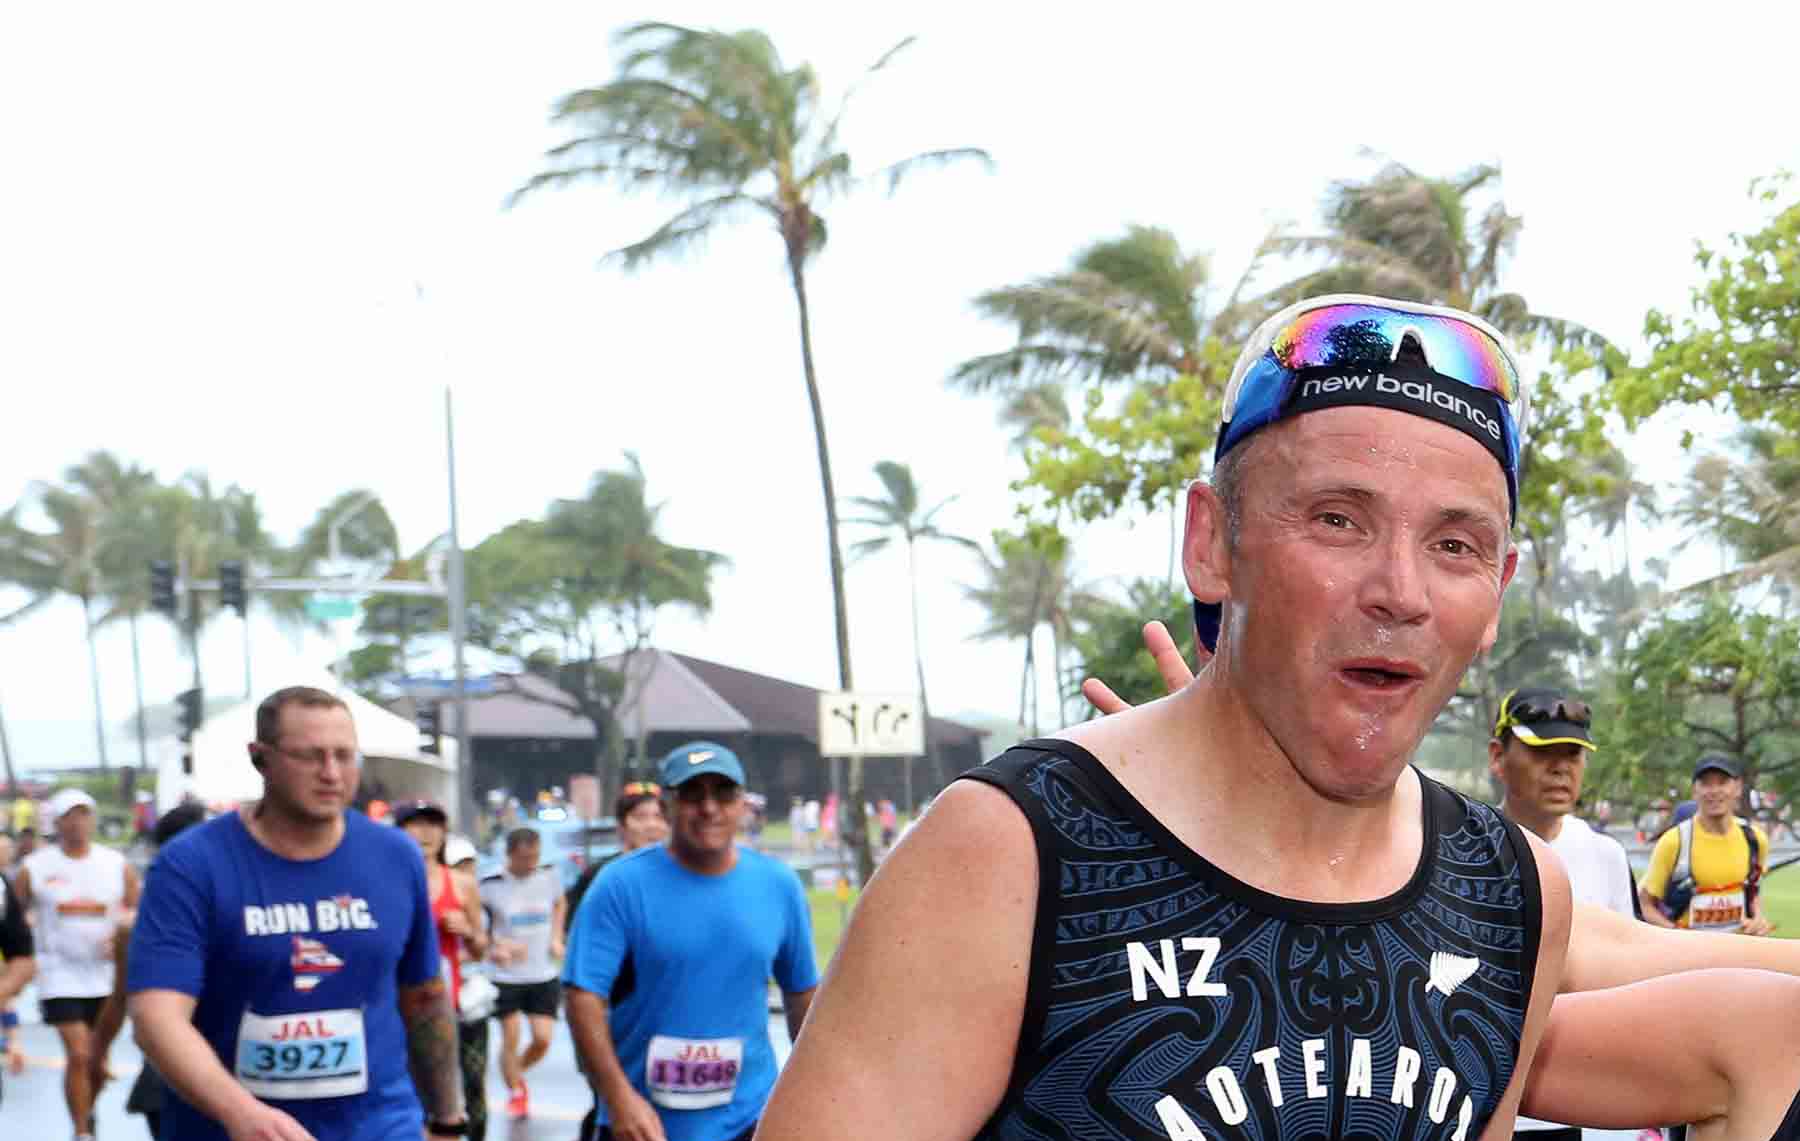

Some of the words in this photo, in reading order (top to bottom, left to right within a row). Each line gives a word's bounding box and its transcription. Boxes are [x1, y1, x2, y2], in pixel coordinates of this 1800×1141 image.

[1302, 375, 1370, 398] new
[1375, 373, 1501, 441] balance
[244, 903, 311, 937] RUN
[1126, 937, 1228, 1002] NZ
[272, 1018, 336, 1042] JAL
[254, 1041, 349, 1073] 3927
